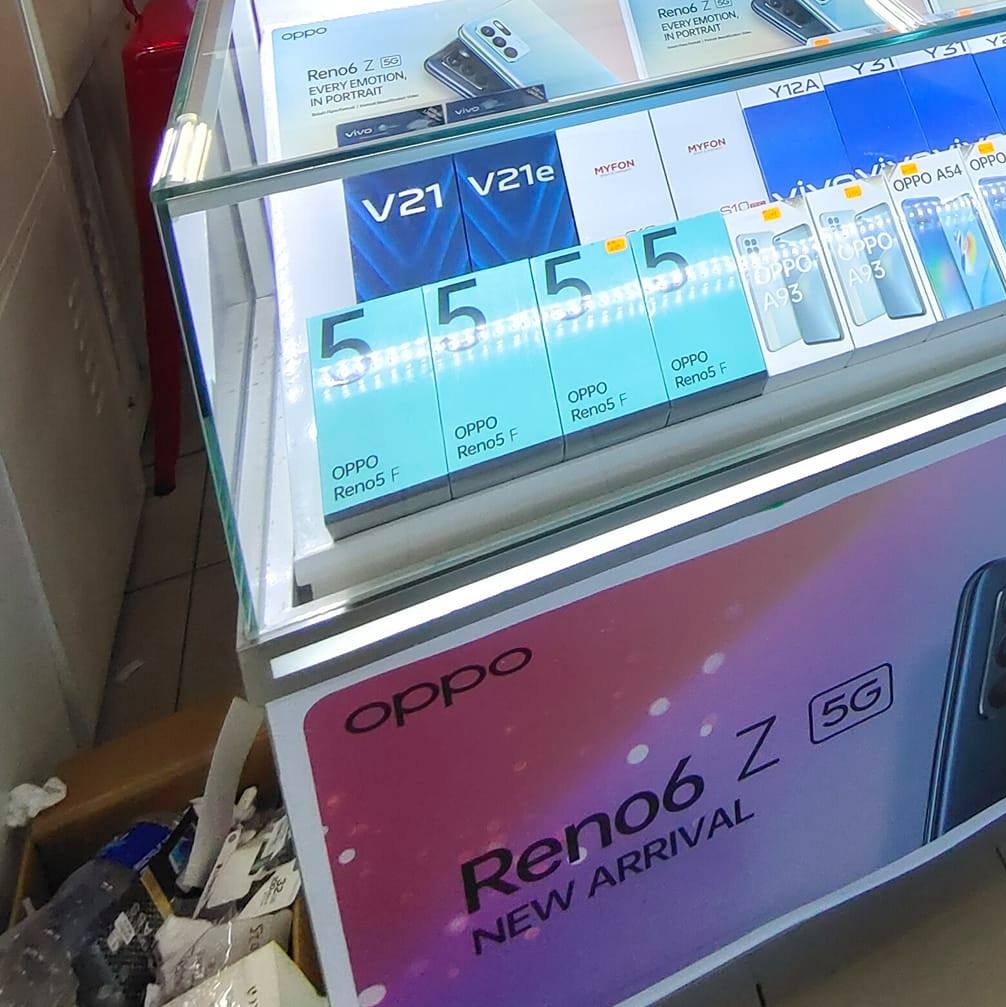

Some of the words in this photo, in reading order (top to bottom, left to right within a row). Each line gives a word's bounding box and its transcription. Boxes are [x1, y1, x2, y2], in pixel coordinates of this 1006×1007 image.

[657, 3, 698, 19] Reno6
[701, 0, 712, 11] Z
[661, 18, 692, 32] EVERY
[693, 10, 740, 26] EMOTION,
[281, 26, 328, 41] oppo
[664, 30, 675, 42] IN
[675, 23, 722, 40] PORTRAIT
[307, 62, 358, 82] Reno6
[364, 59, 375, 72] Z
[381, 56, 400, 67] 5G
[308, 80, 347, 96] EVERY
[349, 70, 407, 89] EMOTION,
[310, 96, 324, 107] IN
[326, 86, 384, 105] PORTRAIT
[768, 78, 820, 99] Y12A
[455, 104, 480, 116] vivo
[344, 127, 373, 138] vivo
[687, 137, 727, 154] MYFON
[466, 163, 556, 196] V21e
[594, 159, 636, 176] MYFON
[893, 171, 932, 192] OPPO
[936, 164, 963, 181] A54
[361, 183, 443, 223] V21
[642, 226, 689, 293] 5
[838, 232, 893, 261] OPPO
[754, 254, 813, 285] OPPO
[849, 260, 886, 286] A93
[545, 251, 592, 321] 5
[764, 283, 804, 311] A93
[437, 278, 487, 352] 5
[321, 308, 373, 388] 5
[671, 350, 709, 372] OPPO
[674, 365, 716, 389] Reno5
[719, 361, 728, 375] F
[567, 381, 608, 404] OPPO
[571, 397, 616, 422] Reno5
[619, 392, 629, 407] F
[454, 415, 498, 440] OPPO
[457, 432, 505, 460] Reno5
[509, 427, 519, 443] F
[331, 454, 379, 481] OPPO
[334, 472, 386, 502] Reno5
[391, 466, 401, 483] F
[344, 645, 533, 734] oppo
[459, 754, 706, 915] Reno6
[735, 715, 781, 783] Z
[815, 672, 886, 735] 5G
[471, 879, 579, 956] NEW
[588, 797, 755, 898] ARRIVAL
